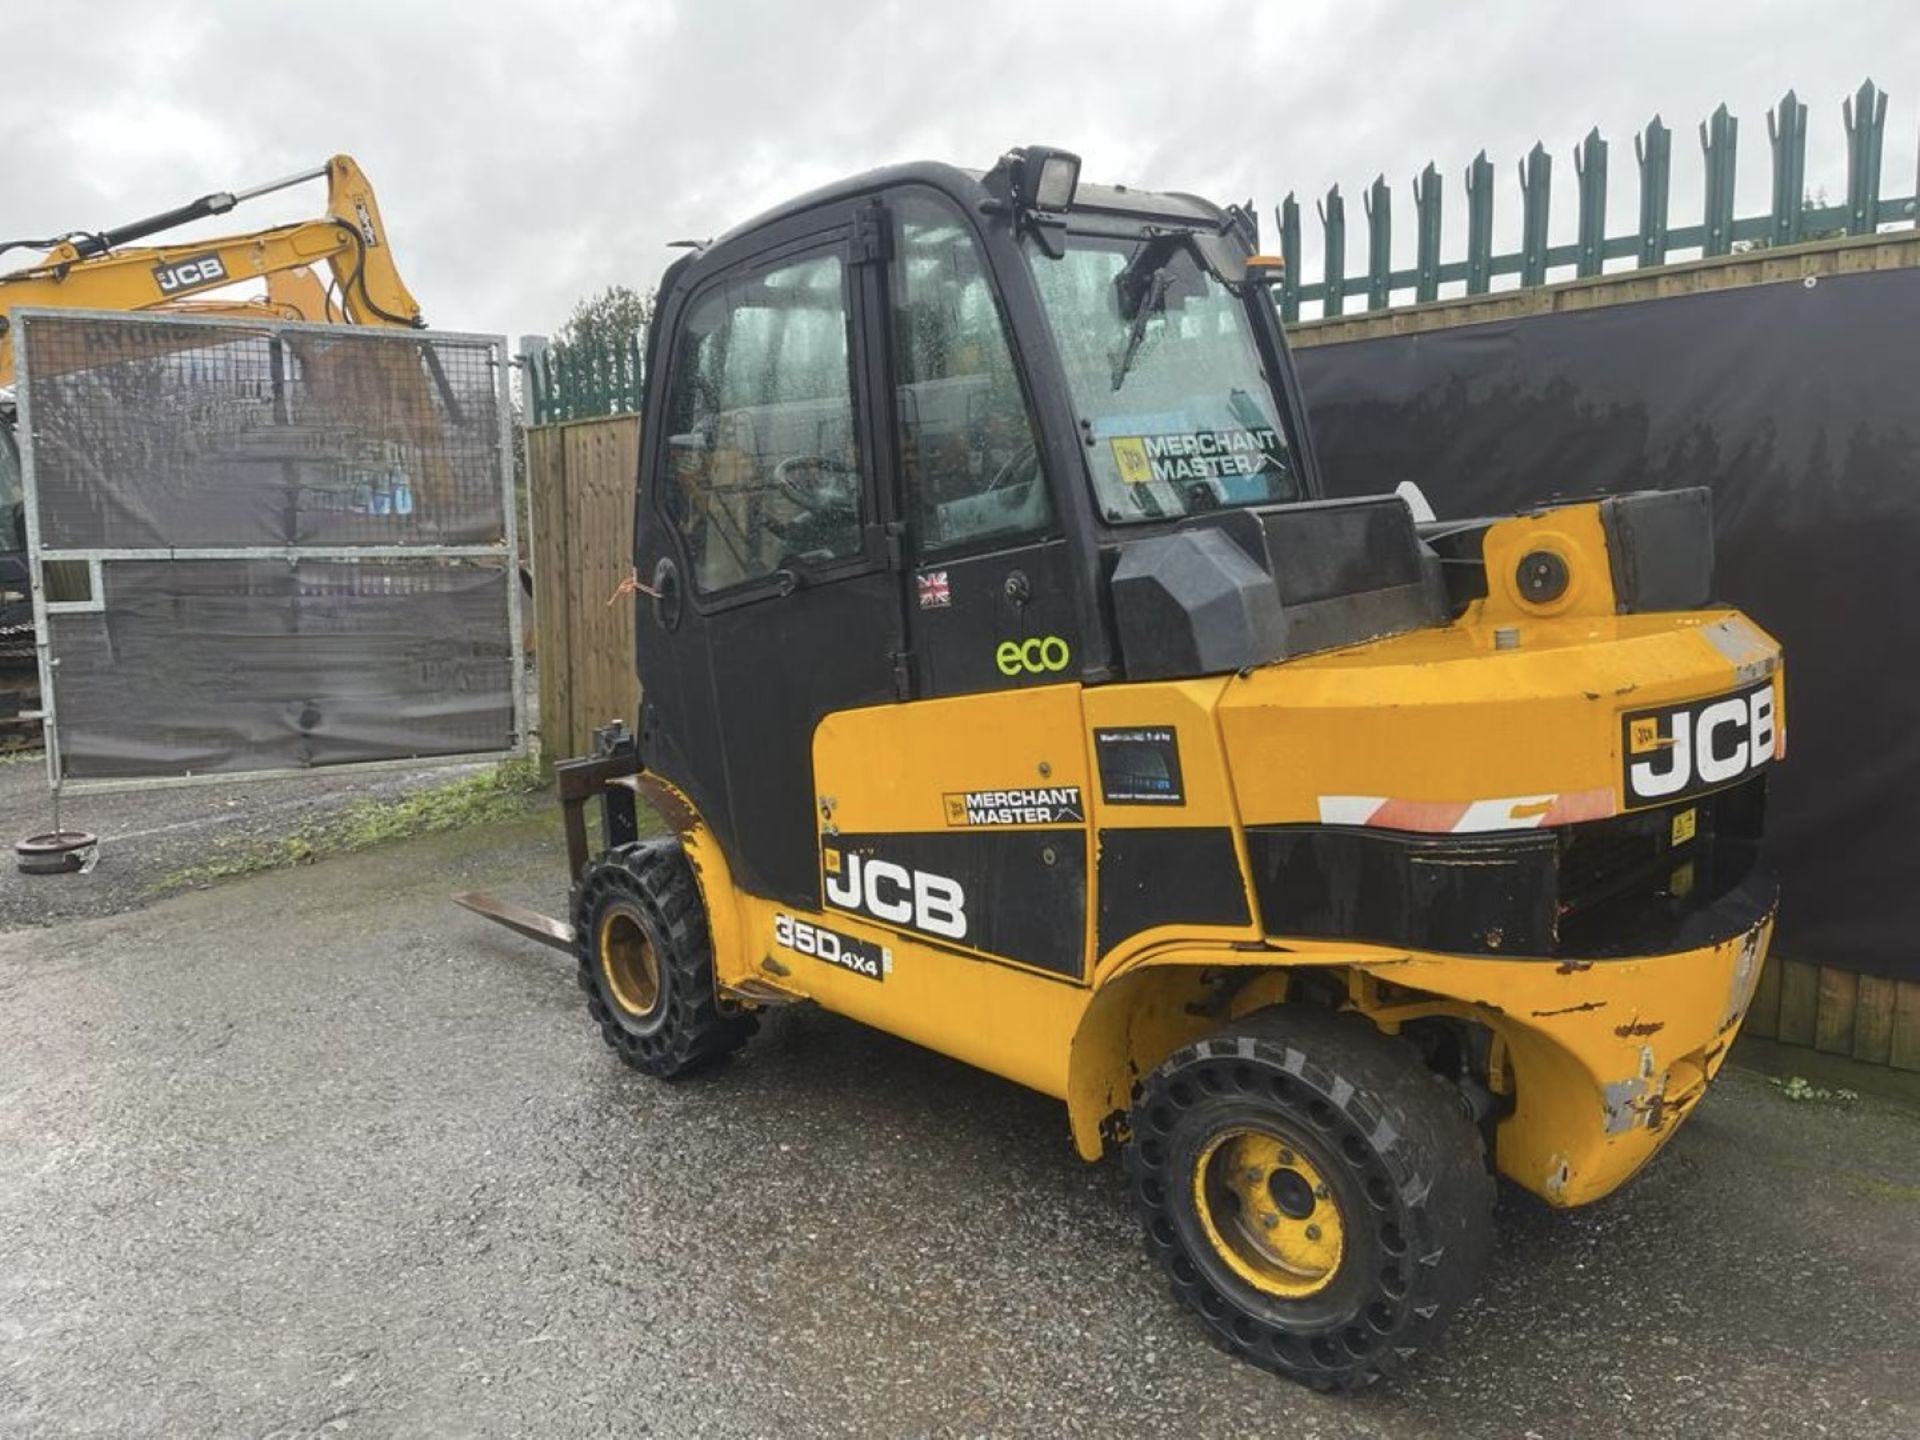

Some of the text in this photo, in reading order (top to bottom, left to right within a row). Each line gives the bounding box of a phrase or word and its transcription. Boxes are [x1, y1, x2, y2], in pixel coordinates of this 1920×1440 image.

[160, 259, 224, 290] JCB
[1144, 430, 1276, 458] MERCHANT
[1151, 454, 1251, 481] MASTER
[996, 635, 1070, 676] eco
[1630, 685, 1776, 798] JCB
[965, 788, 1079, 809] MERCHANT
[968, 807, 1052, 825] MASTER
[825, 853, 968, 940] JCB
